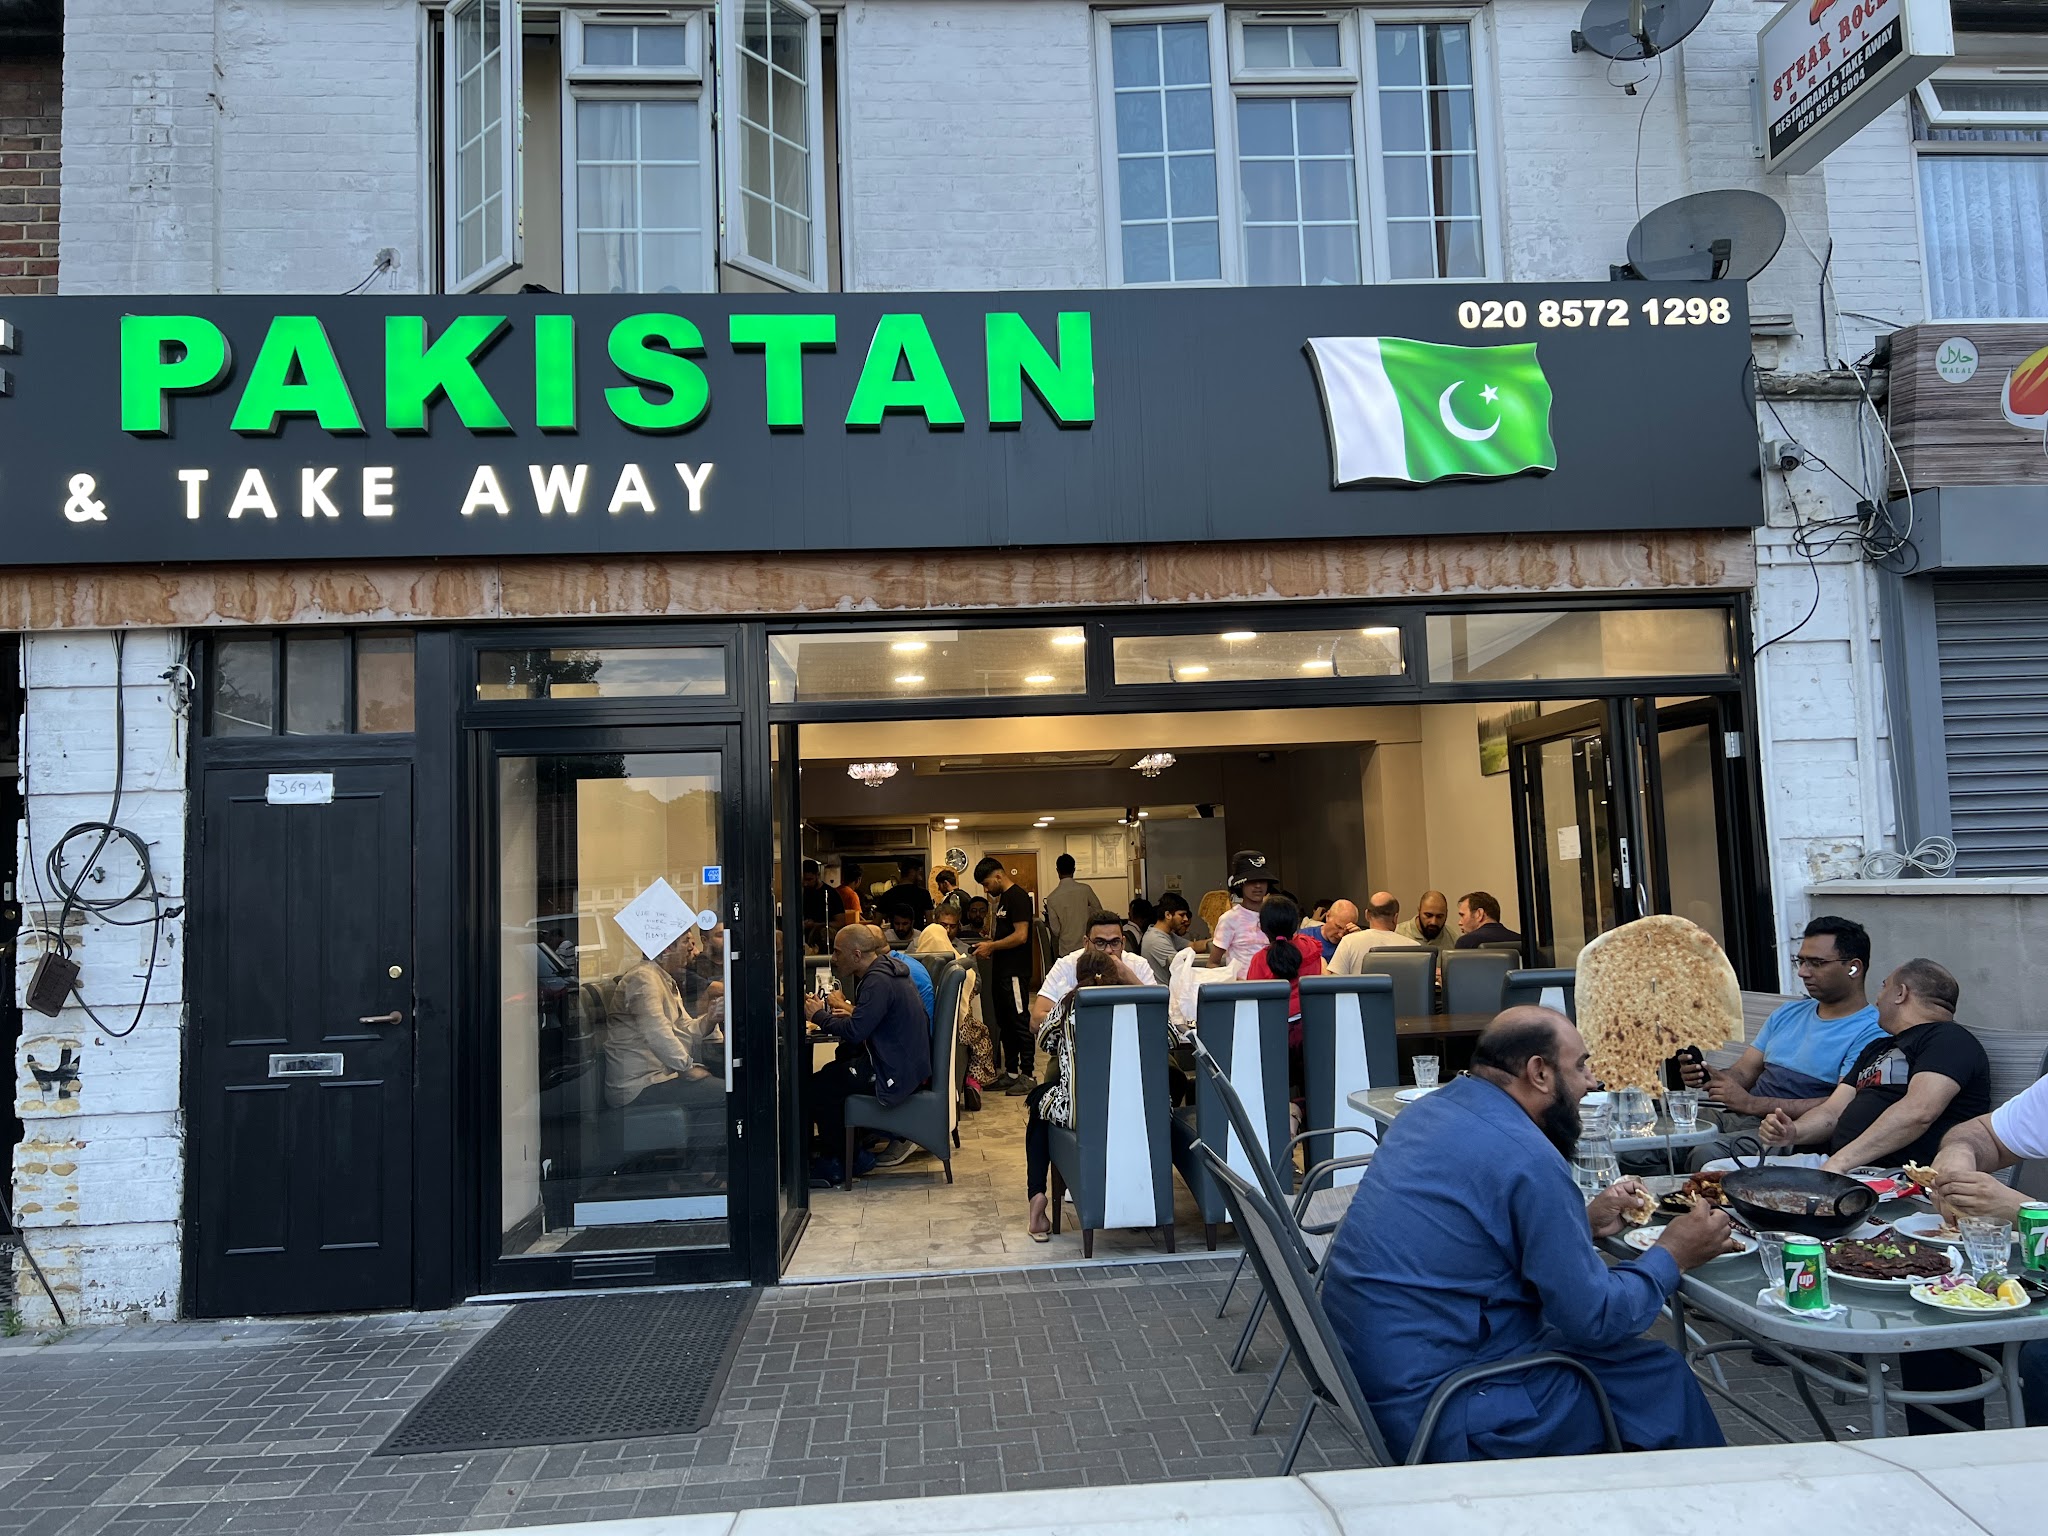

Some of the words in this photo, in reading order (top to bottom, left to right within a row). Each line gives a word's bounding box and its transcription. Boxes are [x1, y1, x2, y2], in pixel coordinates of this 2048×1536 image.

[1773, 32, 1832, 101] STEAK
[1775, 79, 1831, 137] RESTAURANT
[1831, 75, 1840, 89] &
[1839, 50, 1865, 81] TAKE
[1864, 24, 1894, 61] AWAY
[1797, 113, 1815, 133] 020
[1815, 88, 1840, 120] 8569
[1840, 67, 1866, 96] 6004
[1458, 300, 1527, 329] 020
[1538, 298, 1630, 328] 8572
[1641, 297, 1731, 326] 1298
[120, 311, 1096, 434] PAKISTAN
[1940, 345, 1973, 364] حلال
[64, 473, 108, 522] &
[179, 467, 395, 519] TAKE
[460, 463, 714, 515] AWAY
